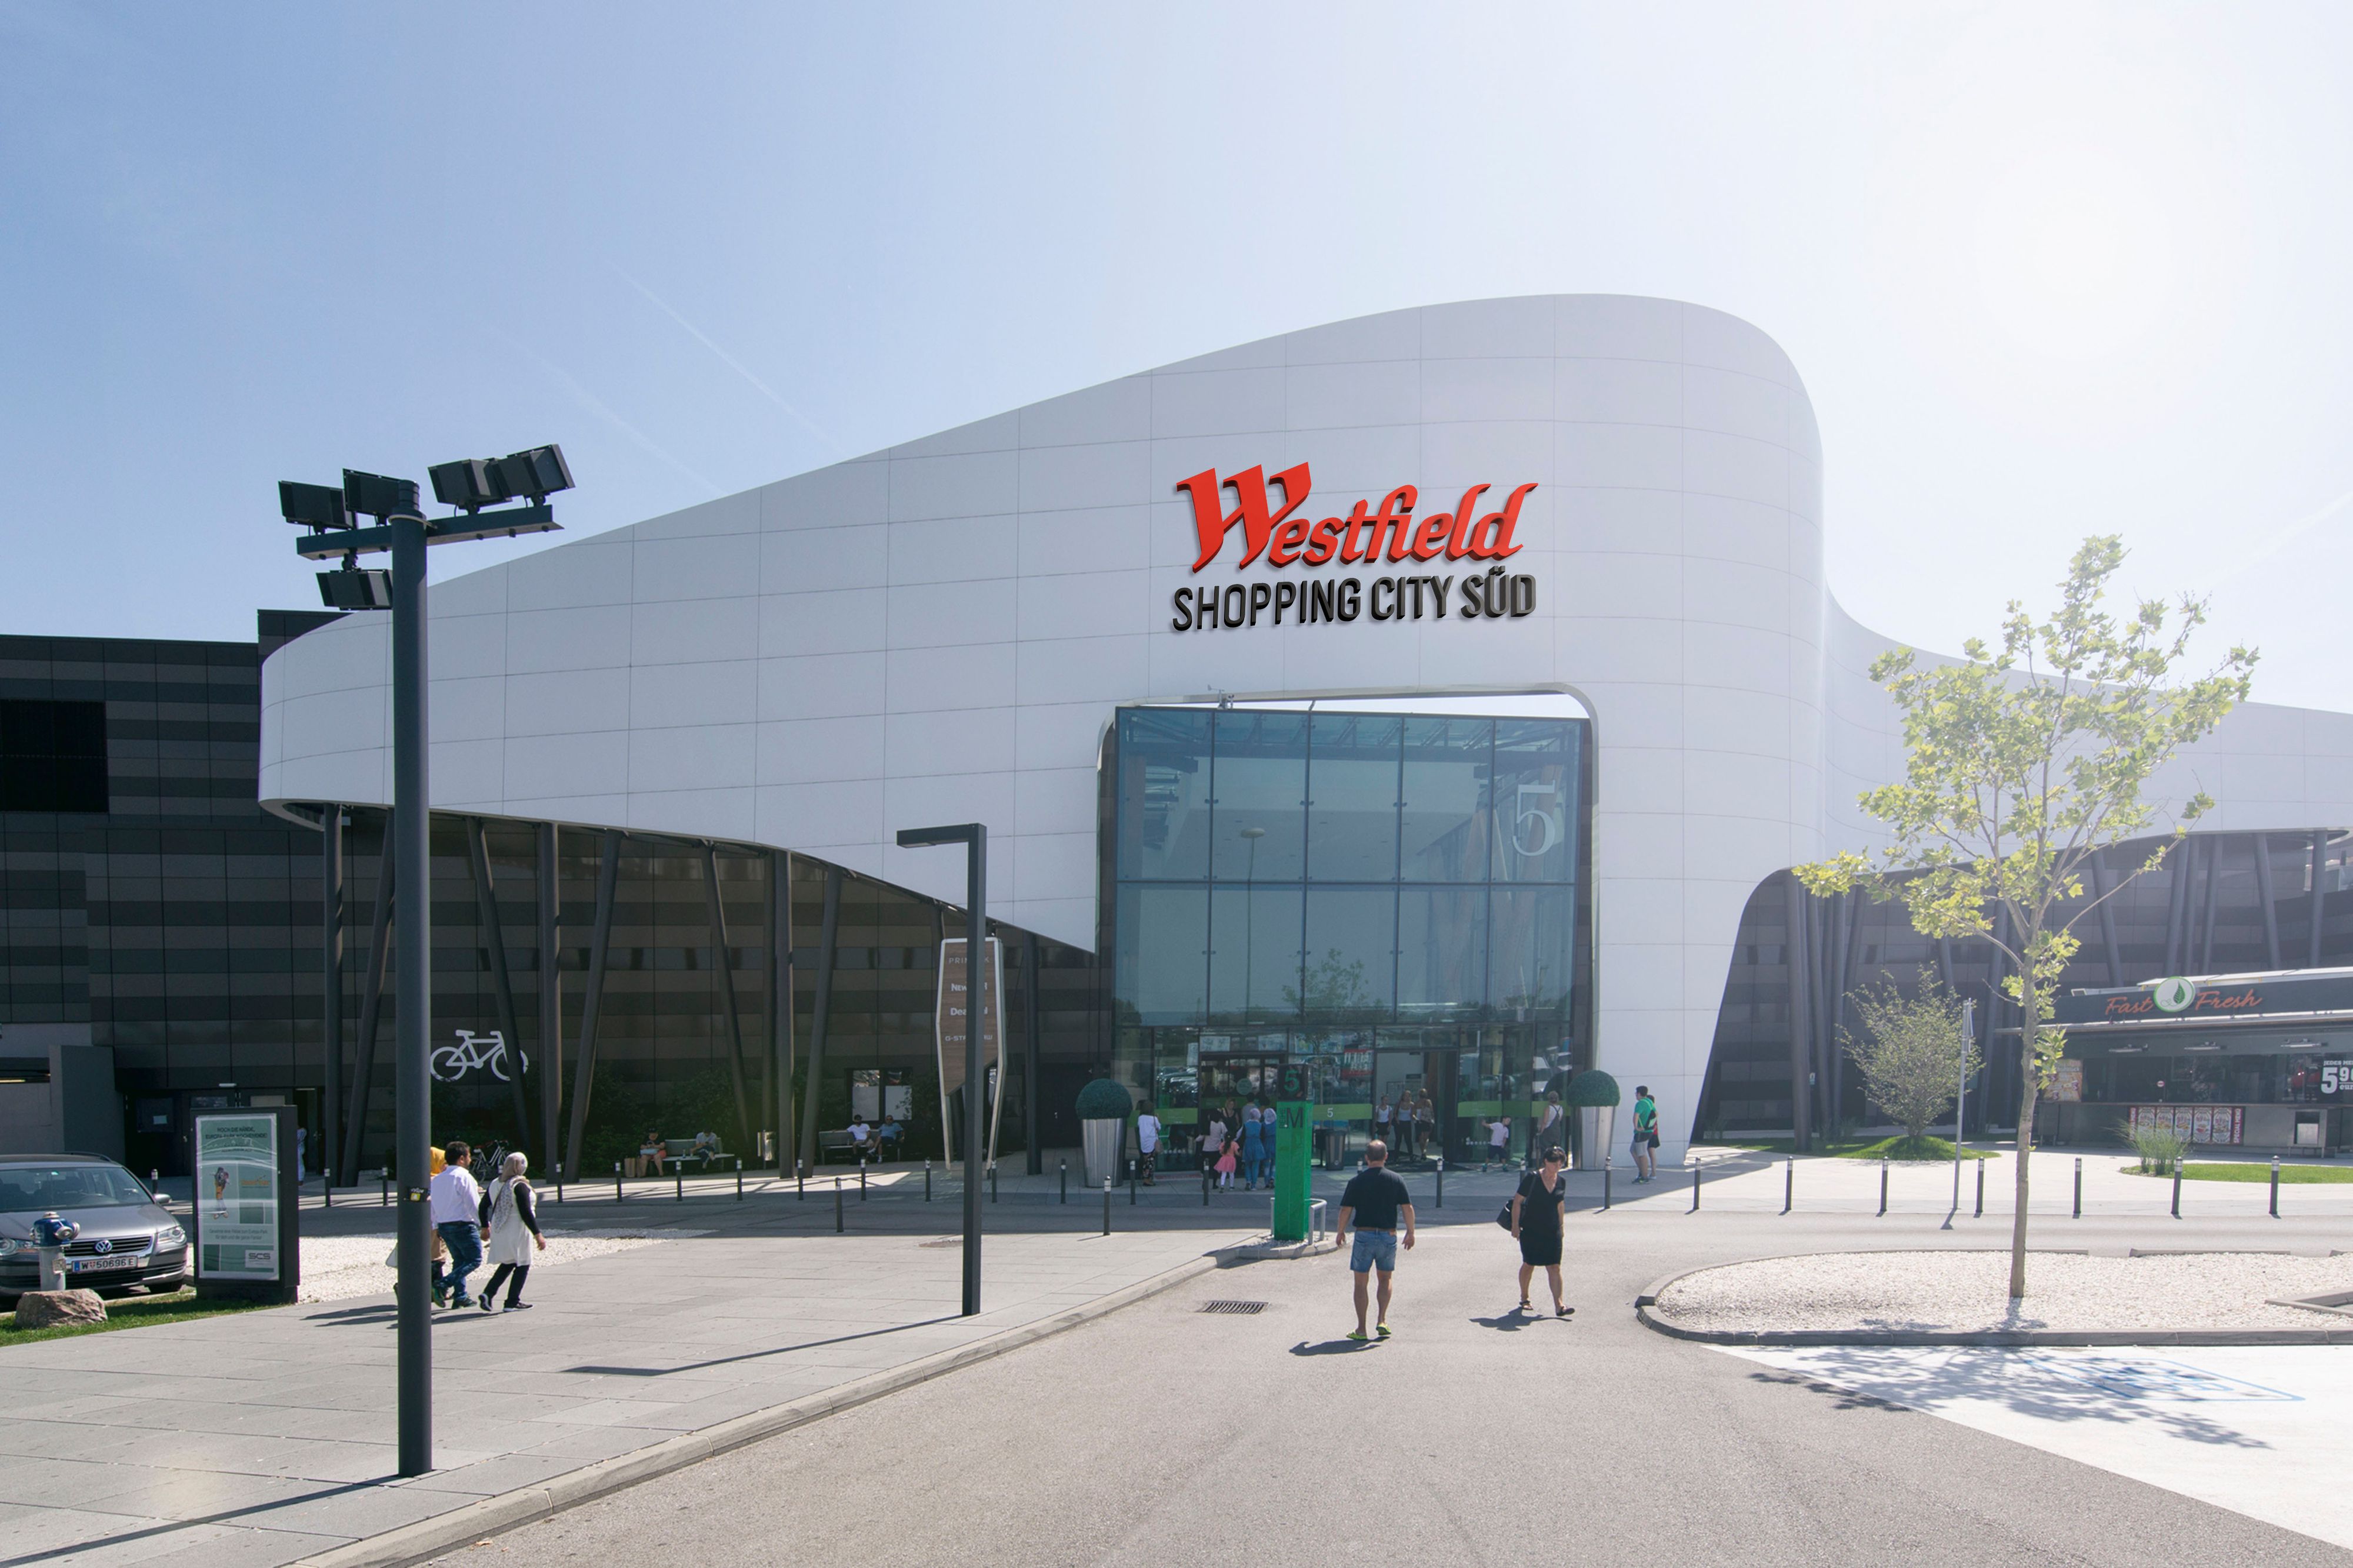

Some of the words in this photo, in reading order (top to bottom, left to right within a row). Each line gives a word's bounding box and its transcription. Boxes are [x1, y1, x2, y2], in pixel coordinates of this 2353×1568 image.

[1175, 462, 1539, 574] Westfield
[1172, 578, 1361, 632] SHOPPING
[1371, 575, 1454, 620] CITY
[1461, 566, 1537, 618] SÜD
[1512, 779, 1556, 856] 5
[2105, 996, 2154, 1015] Fast
[2195, 989, 2263, 1010] Fresh
[1284, 1069, 1299, 1092] 5
[2321, 1066, 2338, 1094] 5
[1287, 1107, 1304, 1129] M
[1327, 1107, 1334, 1117] 5
[81, 1262, 88, 1270] W
[96, 1259, 126, 1268] 50696
